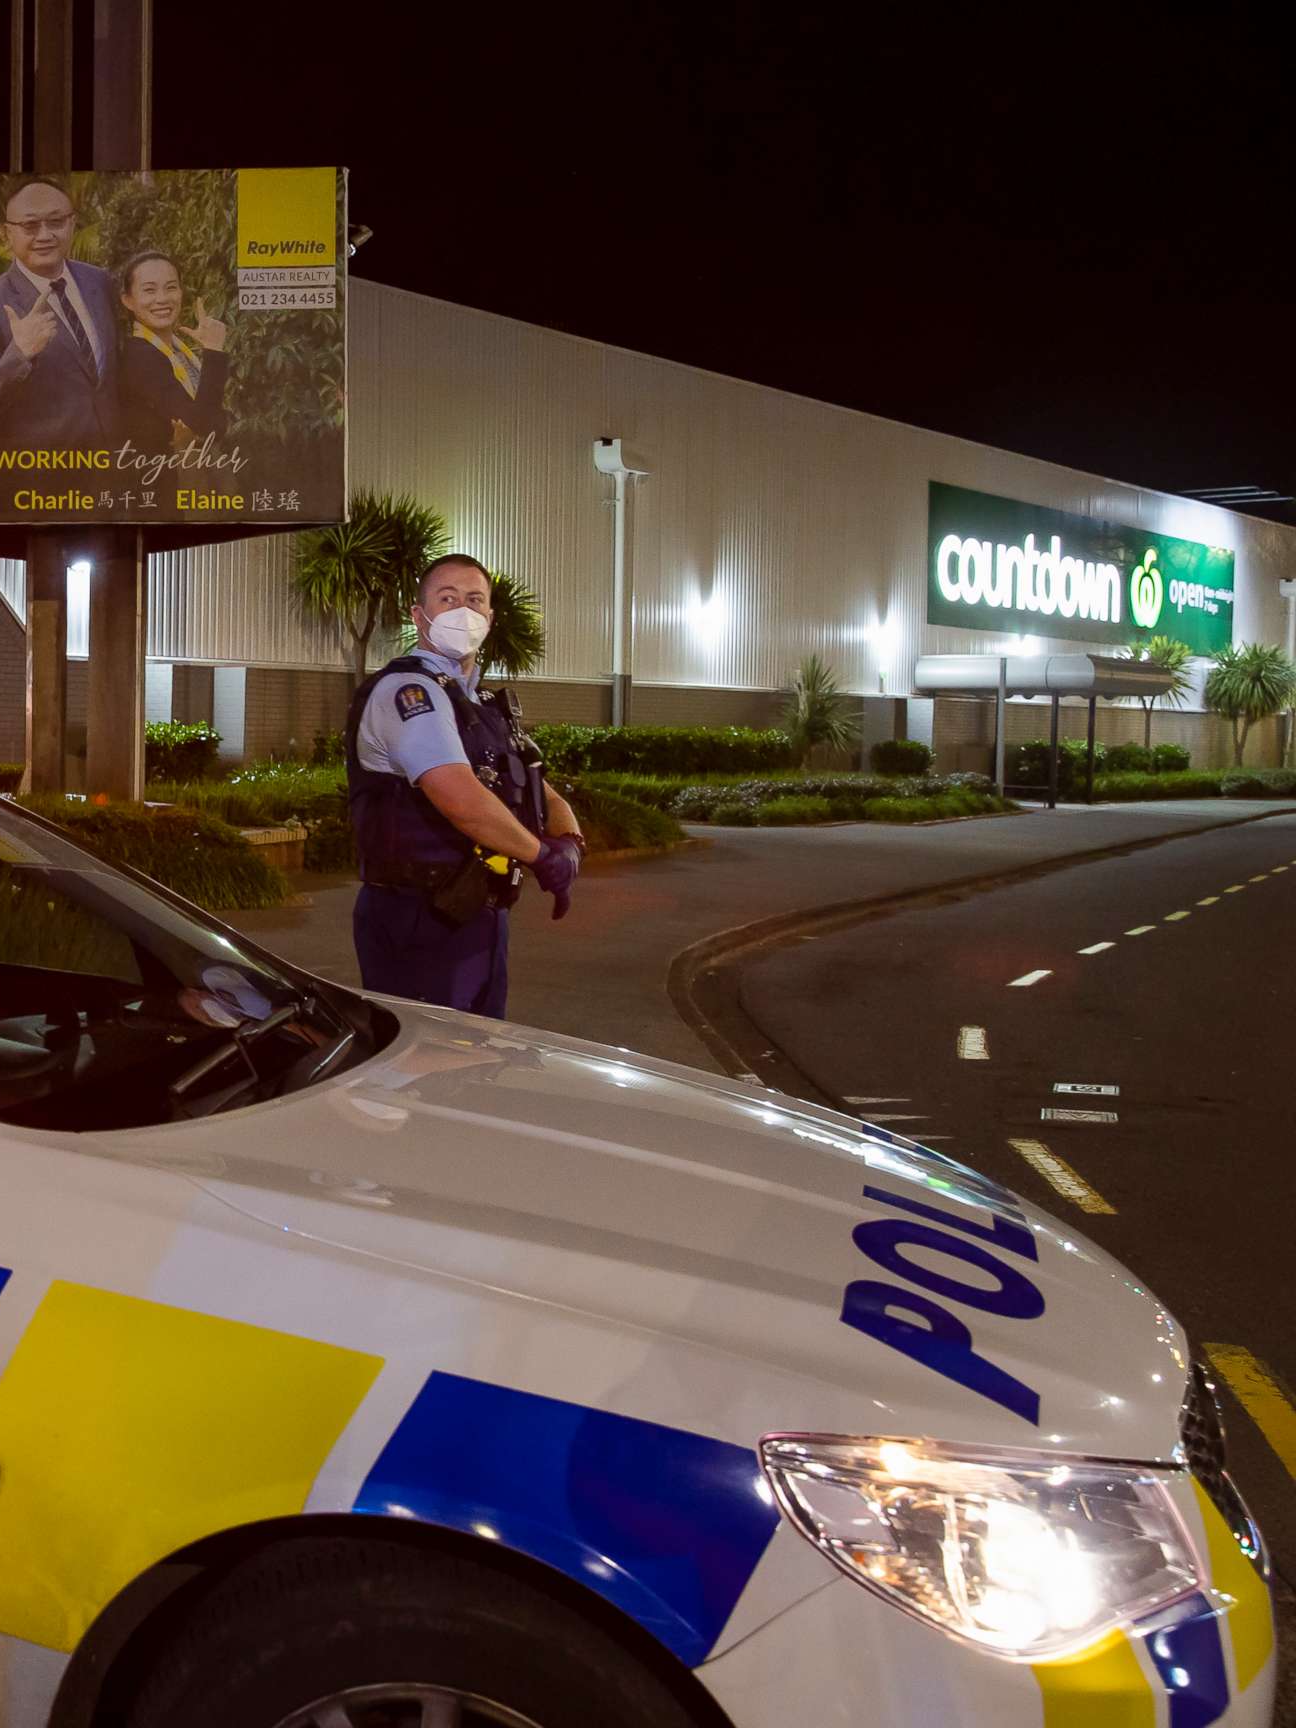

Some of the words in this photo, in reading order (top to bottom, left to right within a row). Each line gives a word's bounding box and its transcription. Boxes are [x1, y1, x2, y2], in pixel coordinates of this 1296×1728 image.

[243, 273, 286, 282] AUSTAR
[289, 271, 330, 281] REALTY
[241, 294, 266, 305] 021
[271, 293, 296, 304] 234
[300, 292, 334, 304] 4455
[113, 431, 249, 486] together
[14, 489, 94, 510] Charlie
[97, 489, 158, 509] 馬千里
[176, 490, 244, 510] Elaine
[937, 533, 1121, 624] countdown
[1169, 579, 1204, 613] open
